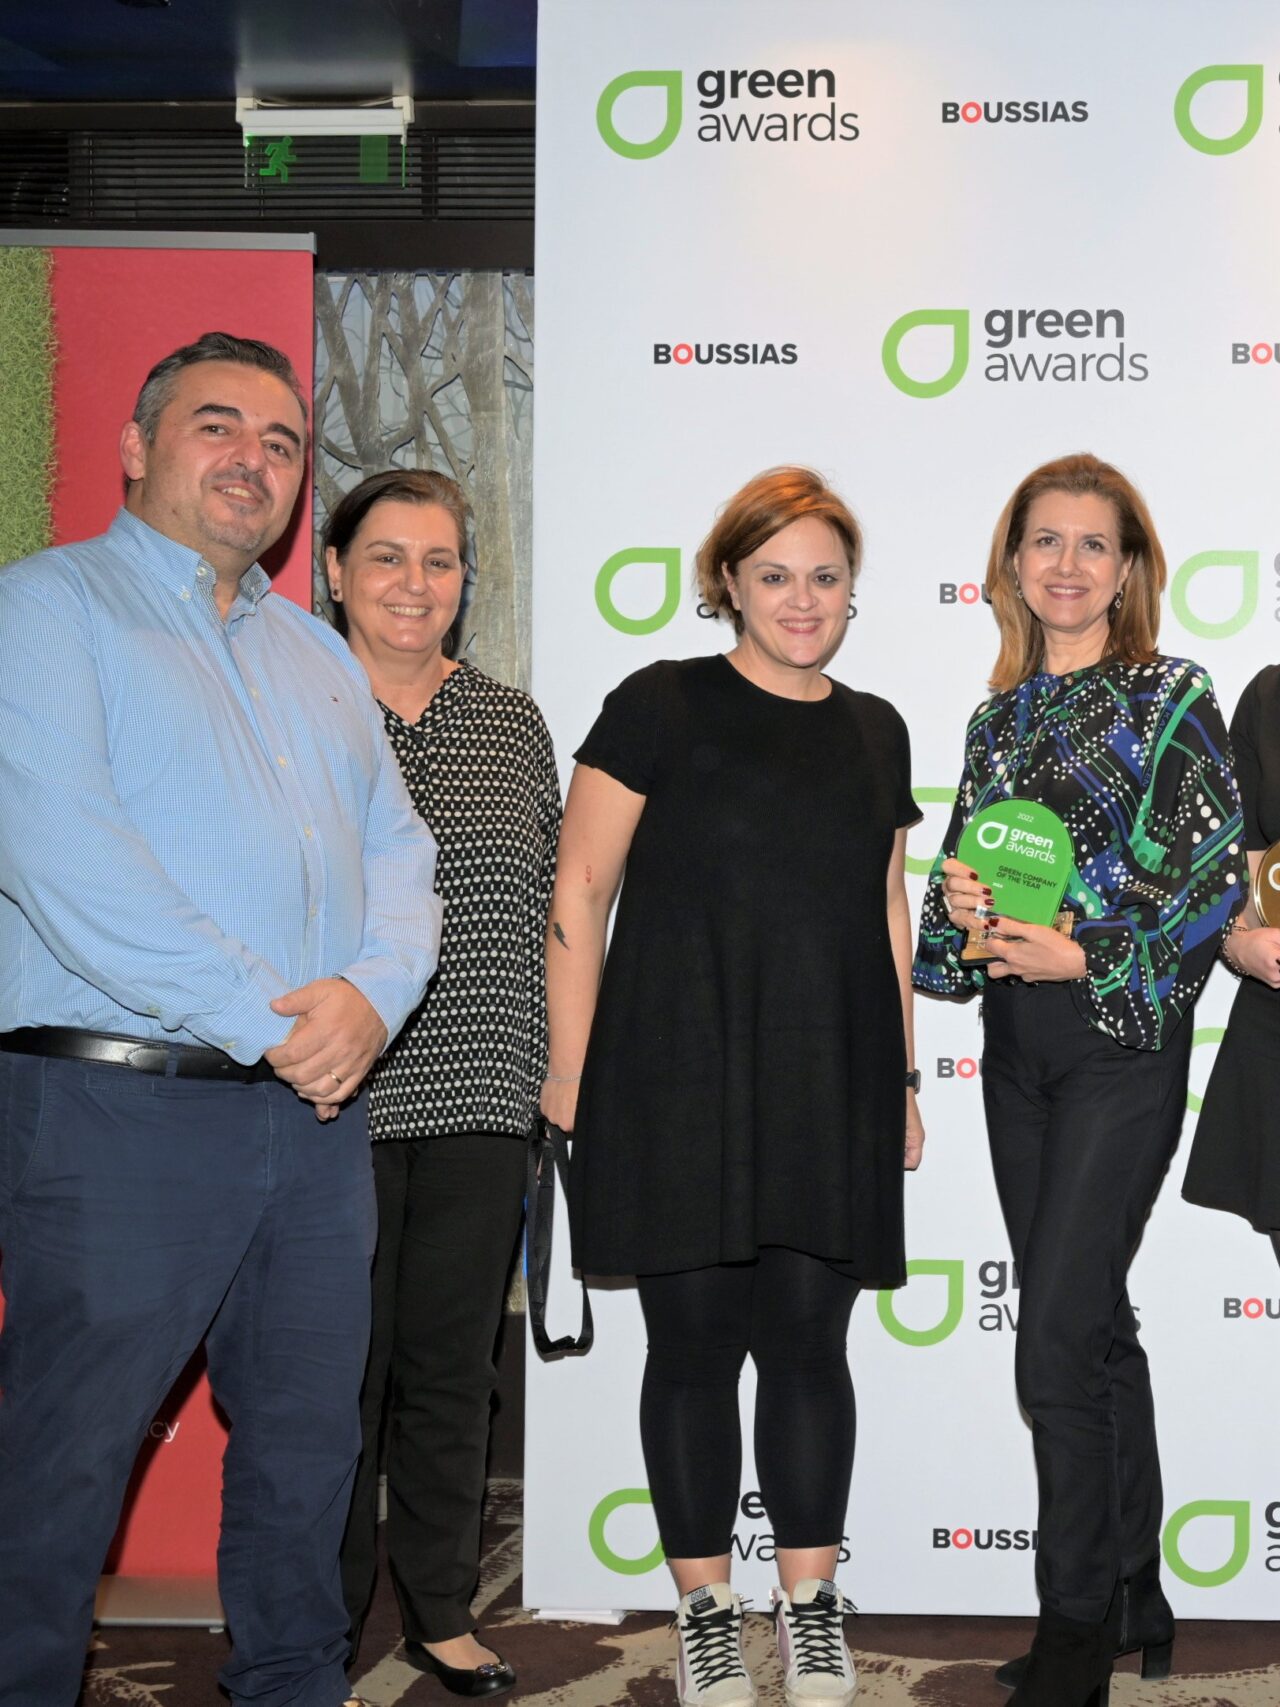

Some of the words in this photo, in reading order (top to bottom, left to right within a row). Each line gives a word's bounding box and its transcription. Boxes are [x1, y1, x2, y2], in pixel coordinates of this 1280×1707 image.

[697, 69, 836, 110] green
[697, 101, 860, 143] awards
[941, 100, 1089, 124] BOUSSIAS
[985, 308, 1125, 349] green
[653, 343, 798, 365] BOUSSIAS
[985, 342, 1149, 382] awards
[1017, 812, 1035, 823] 2022
[1009, 828, 1054, 850] green
[1006, 840, 1057, 864] awards
[996, 871, 1006, 879] OF
[1007, 874, 1020, 884] THE
[1021, 878, 1041, 890] YEAR
[998, 865, 1022, 877] GREEN
[1023, 872, 1058, 888] COMPANY
[933, 1528, 1038, 1551] BOUSSI
